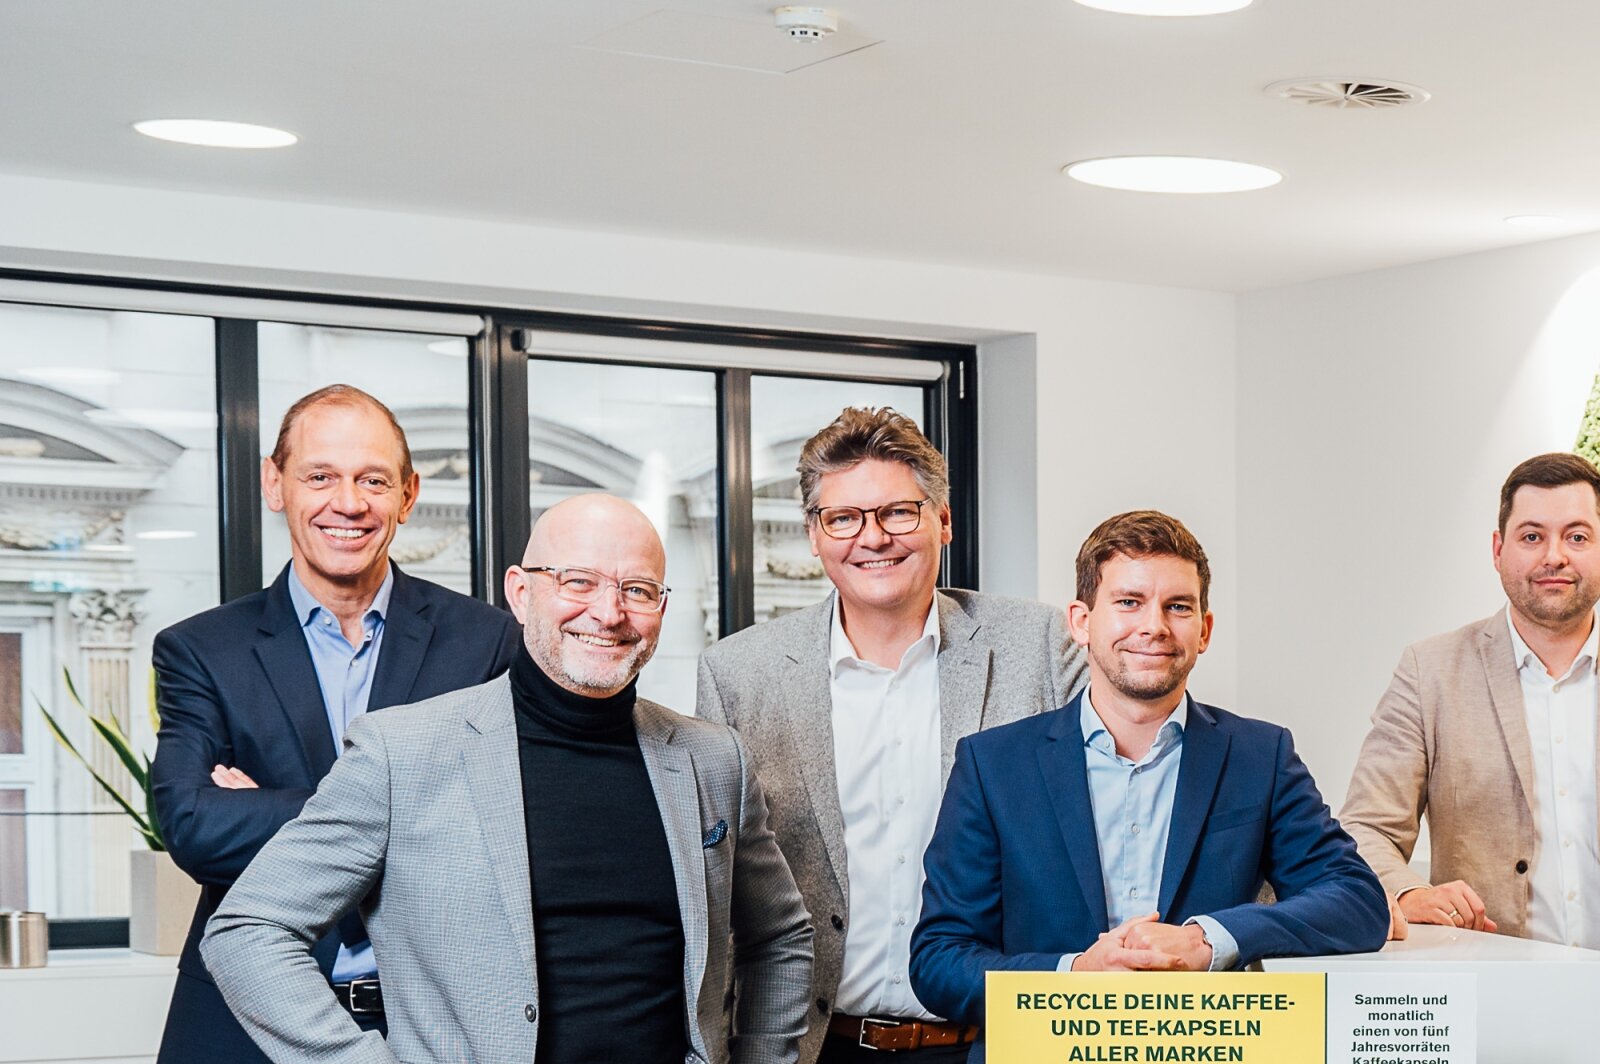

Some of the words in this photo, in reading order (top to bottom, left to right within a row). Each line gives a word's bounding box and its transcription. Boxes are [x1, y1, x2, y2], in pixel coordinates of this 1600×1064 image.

[1016, 993, 1118, 1011] RECYCLE
[1124, 993, 1195, 1010] DEINE
[1201, 994, 1295, 1011] KAFFEE-
[1354, 993, 1418, 1006] Sammeln
[1422, 994, 1448, 1005] und
[1368, 1010, 1434, 1021] monatlich
[1051, 1019, 1101, 1036] UND
[1106, 1019, 1261, 1037] TEE-KAPSELN
[1352, 1025, 1390, 1037] einen
[1393, 1028, 1418, 1037] von
[1422, 1025, 1449, 1037] fünf
[1068, 1045, 1139, 1062] ALLER
[1145, 1045, 1243, 1062] MARKEN
[1350, 1041, 1450, 1053] Jahresvorräten
